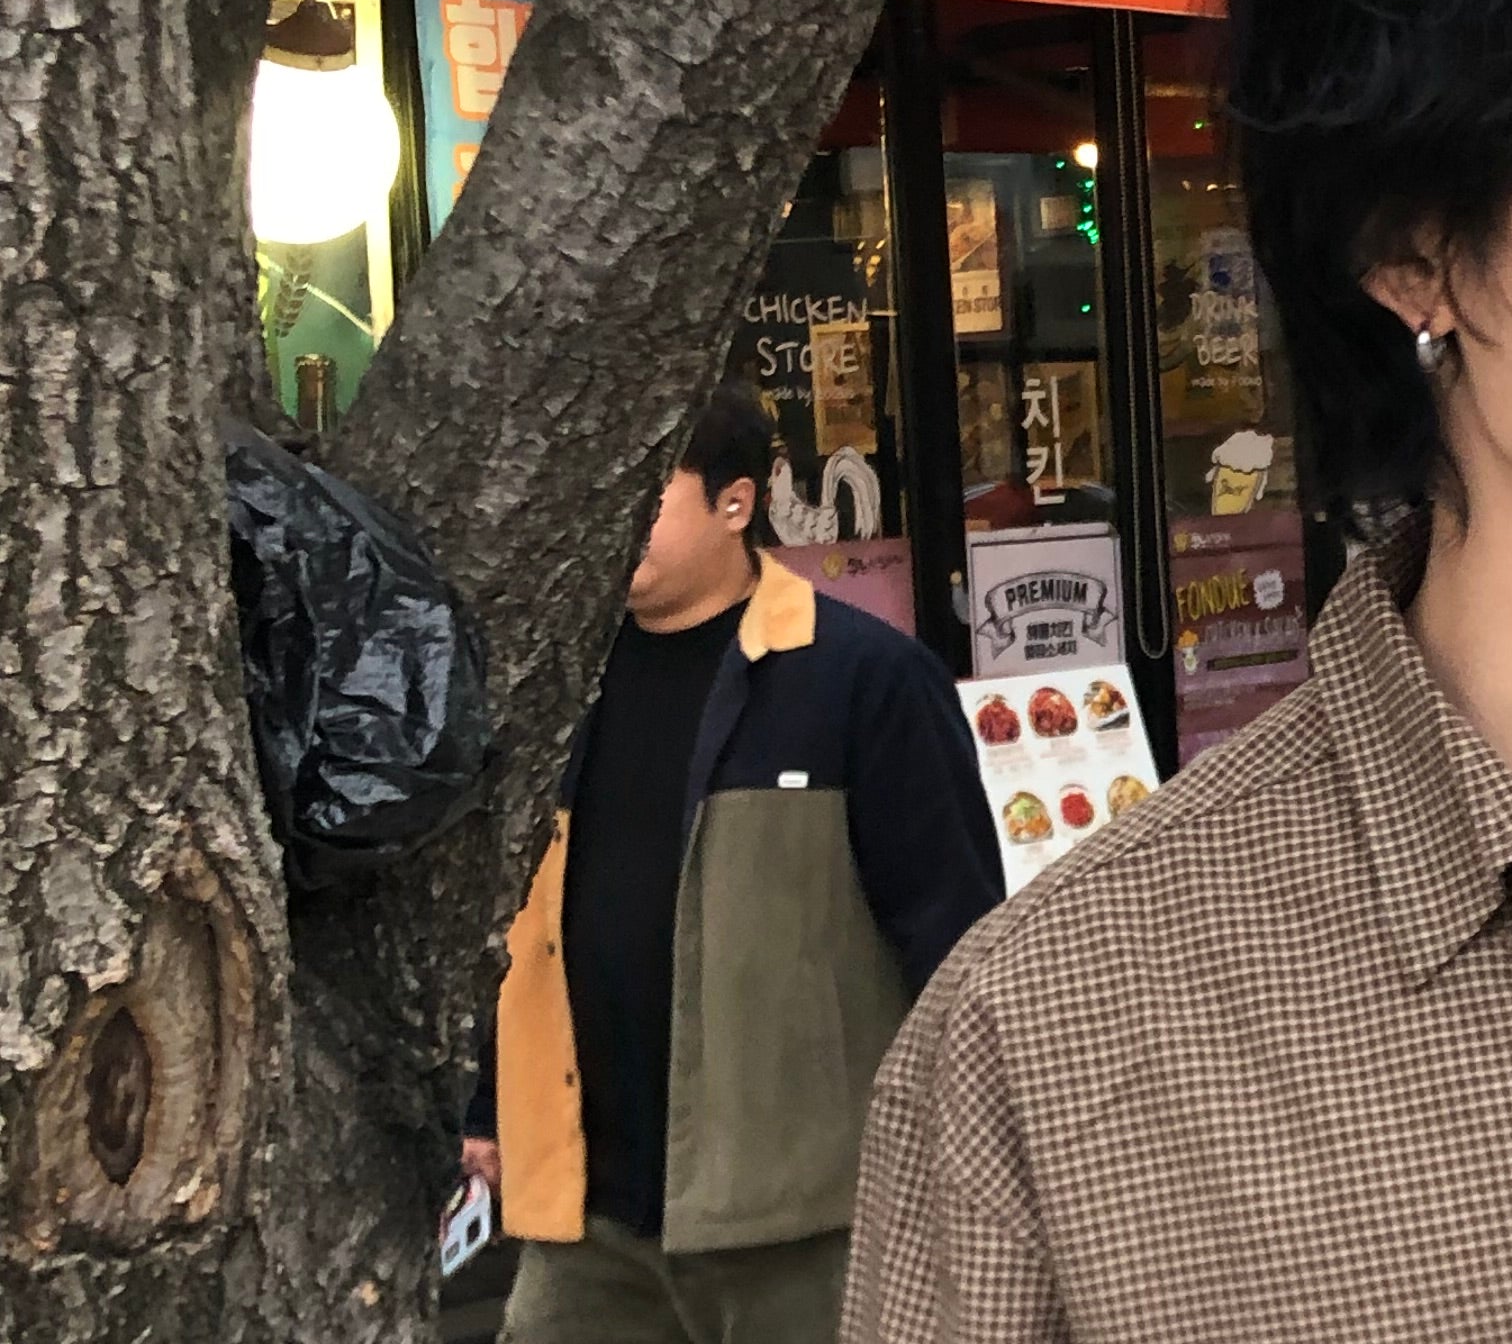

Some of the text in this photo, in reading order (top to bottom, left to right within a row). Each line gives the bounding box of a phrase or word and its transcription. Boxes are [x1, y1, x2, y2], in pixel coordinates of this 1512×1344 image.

[743, 293, 868, 325] CHICKEN
[756, 336, 860, 376] STORE
[1020, 377, 1067, 507] 치킨
[1004, 578, 1089, 612] PREMIUM
[1176, 568, 1250, 624] FONDUE
